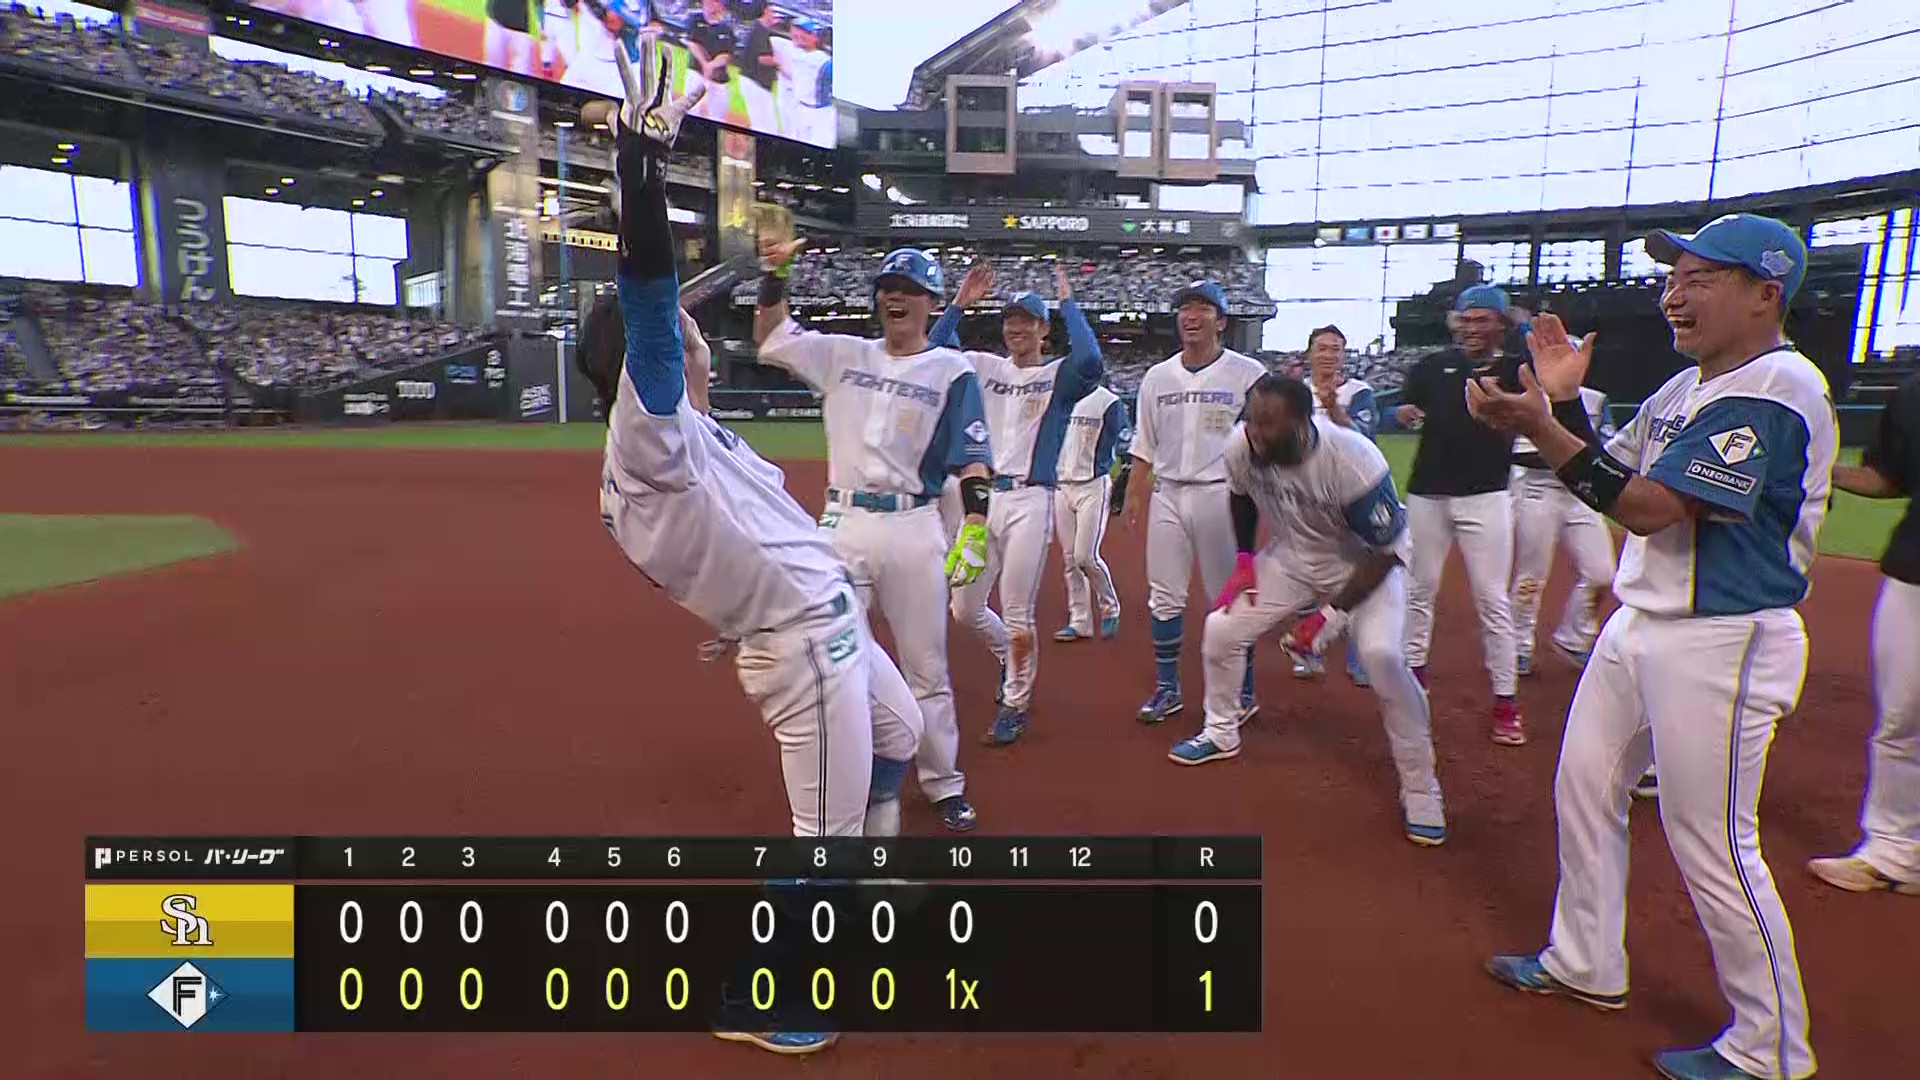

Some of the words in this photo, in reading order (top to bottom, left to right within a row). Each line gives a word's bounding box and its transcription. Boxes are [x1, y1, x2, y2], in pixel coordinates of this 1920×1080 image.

[1019, 215, 1090, 232] SAPPORO
[839, 367, 942, 408] FIGHTERS
[984, 379, 1053, 397] FIGHTERS
[1156, 391, 1235, 408] FIGHTERS
